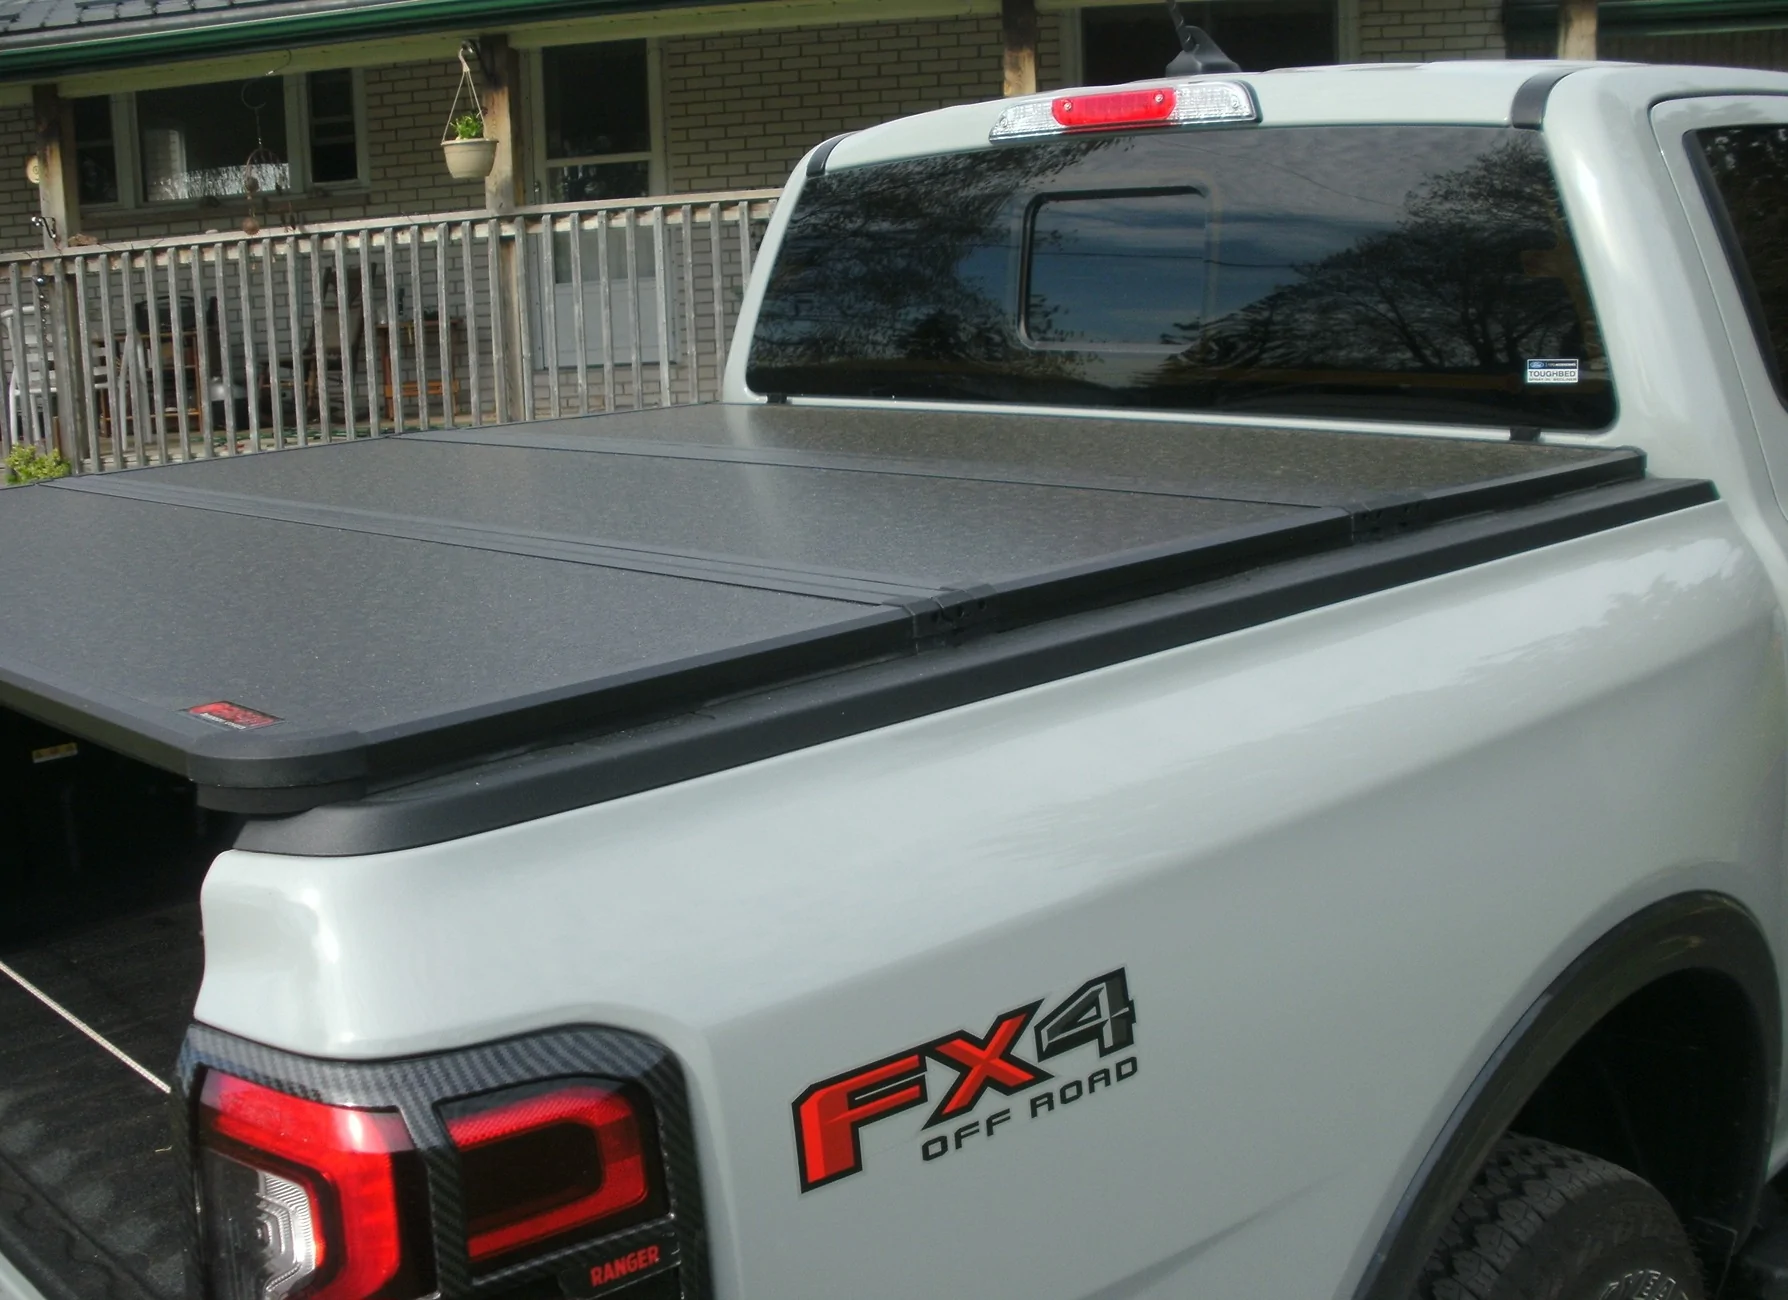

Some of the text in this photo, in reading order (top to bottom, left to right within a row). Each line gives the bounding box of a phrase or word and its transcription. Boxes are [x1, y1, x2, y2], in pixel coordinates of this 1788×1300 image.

[791, 967, 1136, 1194] FX4
[922, 1056, 1137, 1161] OFF ROAD
[590, 1245, 660, 1288] RANGER
